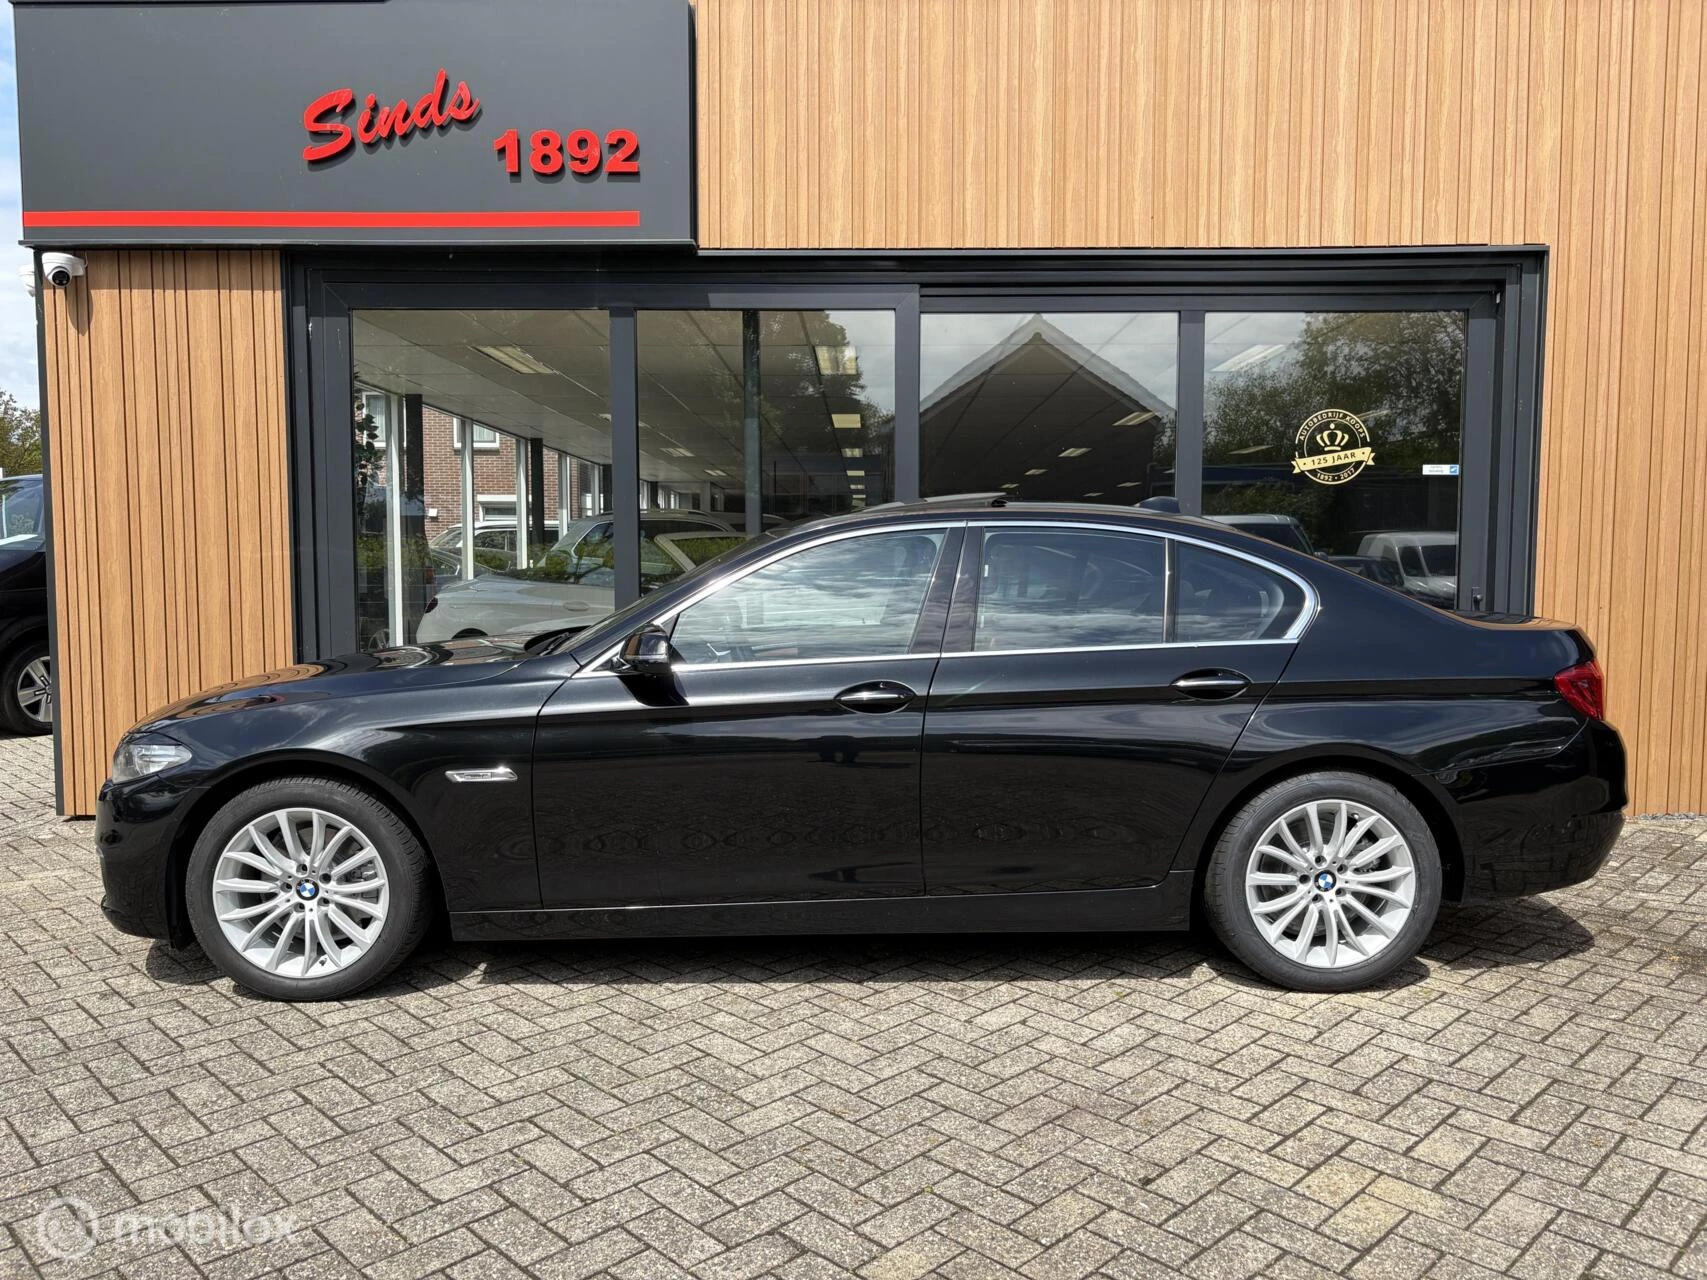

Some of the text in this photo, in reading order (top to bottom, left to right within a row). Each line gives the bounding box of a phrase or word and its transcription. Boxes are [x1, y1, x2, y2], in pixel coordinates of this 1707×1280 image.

[302, 68, 640, 176] Sinds 1892
[1299, 411, 1366, 441] AUTOBEDRIJF KOOPS
[1311, 451, 1356, 466] 125 JAAR
[1316, 467, 1355, 482] 1892 2017
